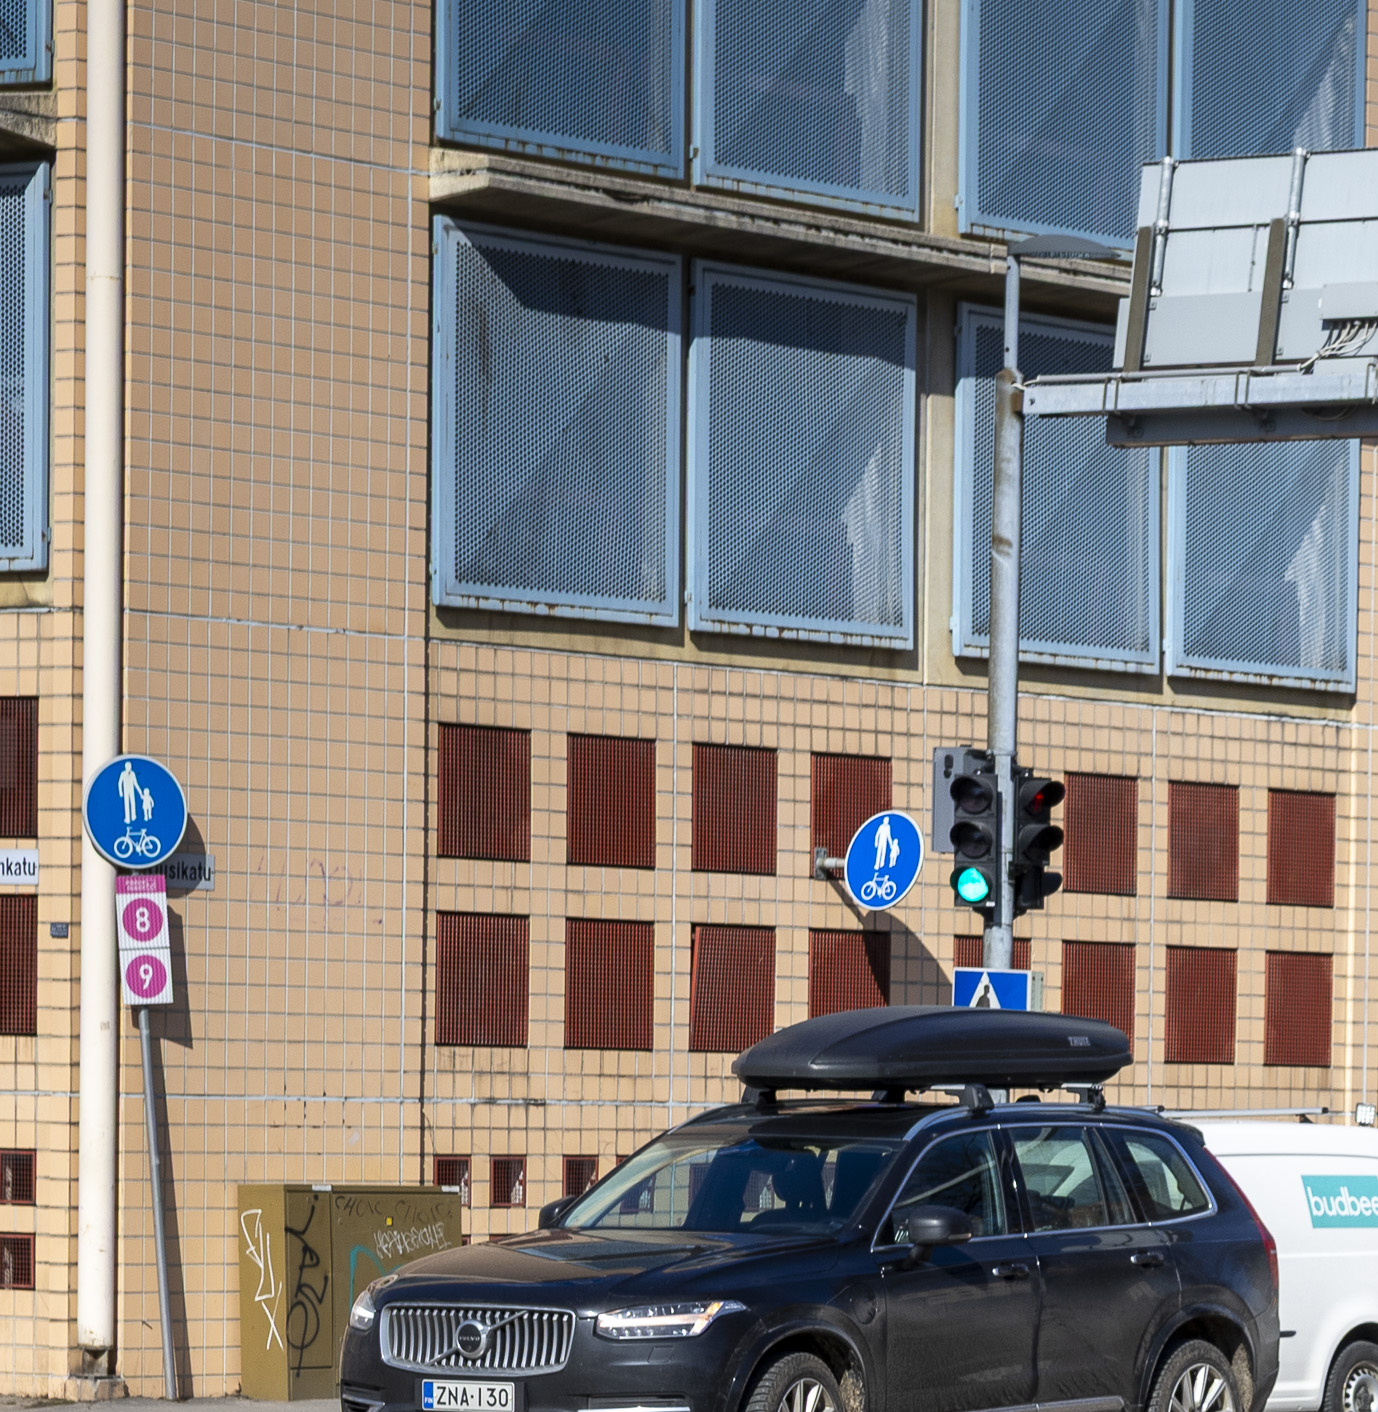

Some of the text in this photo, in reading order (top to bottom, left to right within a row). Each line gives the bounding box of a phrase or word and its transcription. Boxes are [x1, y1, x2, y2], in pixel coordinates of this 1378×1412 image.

[136, 907, 150, 933] 8
[140, 963, 153, 990] 9
[436, 1386, 509, 1408] ZNA-130
